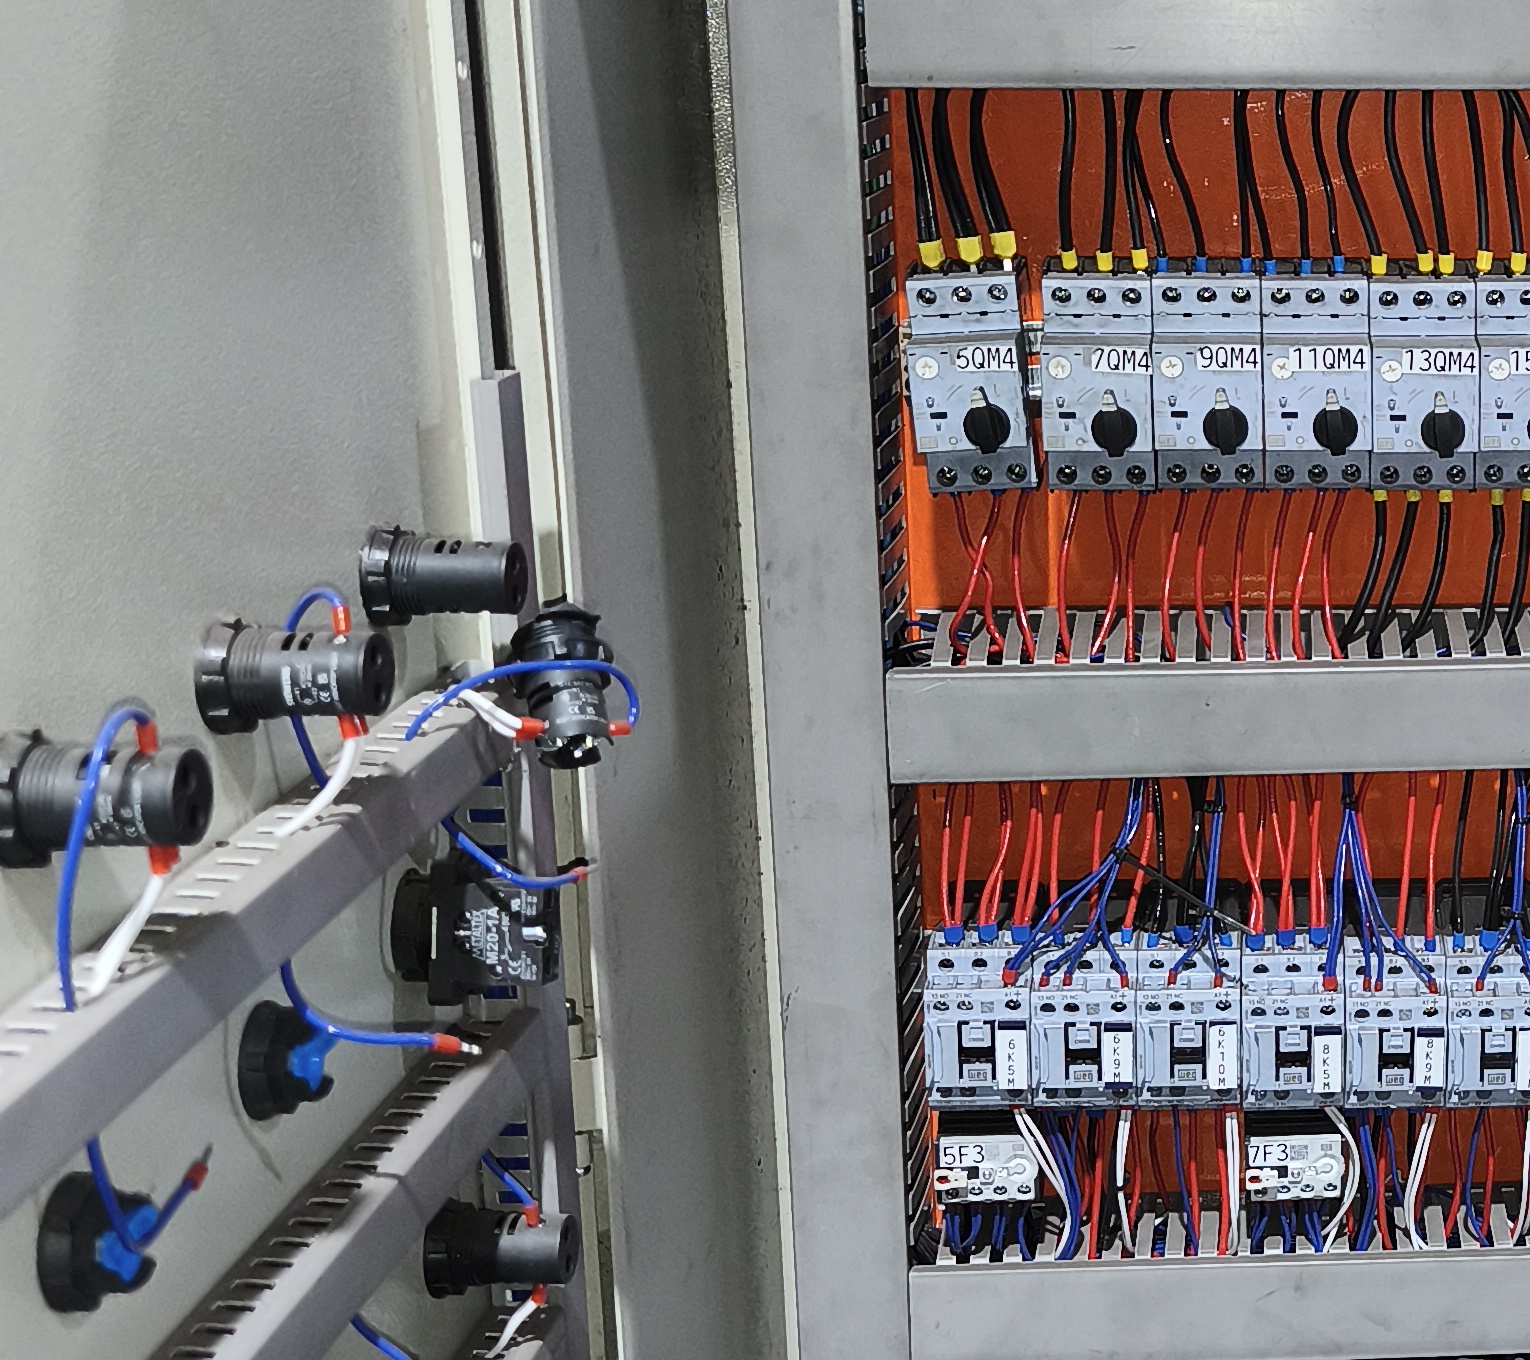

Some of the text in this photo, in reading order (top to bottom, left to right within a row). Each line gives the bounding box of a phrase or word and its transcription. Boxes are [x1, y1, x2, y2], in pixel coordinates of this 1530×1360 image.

[956, 347, 1016, 369] 5QM4
[1094, 348, 1151, 371] 7QM4
[1200, 346, 1259, 369] 9QM4
[1293, 347, 1366, 370] 11QM4
[1405, 350, 1477, 373] 13QM4
[486, 906, 500, 965] M20-1A
[1007, 1038, 1016, 1088] 6K5M
[1113, 1033, 1122, 1083] 6K9M
[1217, 1026, 1226, 1087] 6K10M
[1322, 1043, 1331, 1090] 8K5M
[1424, 1039, 1434, 1085] 8K9M
[943, 1144, 985, 1166] 5F3
[1249, 1143, 1289, 1164] 7F3
